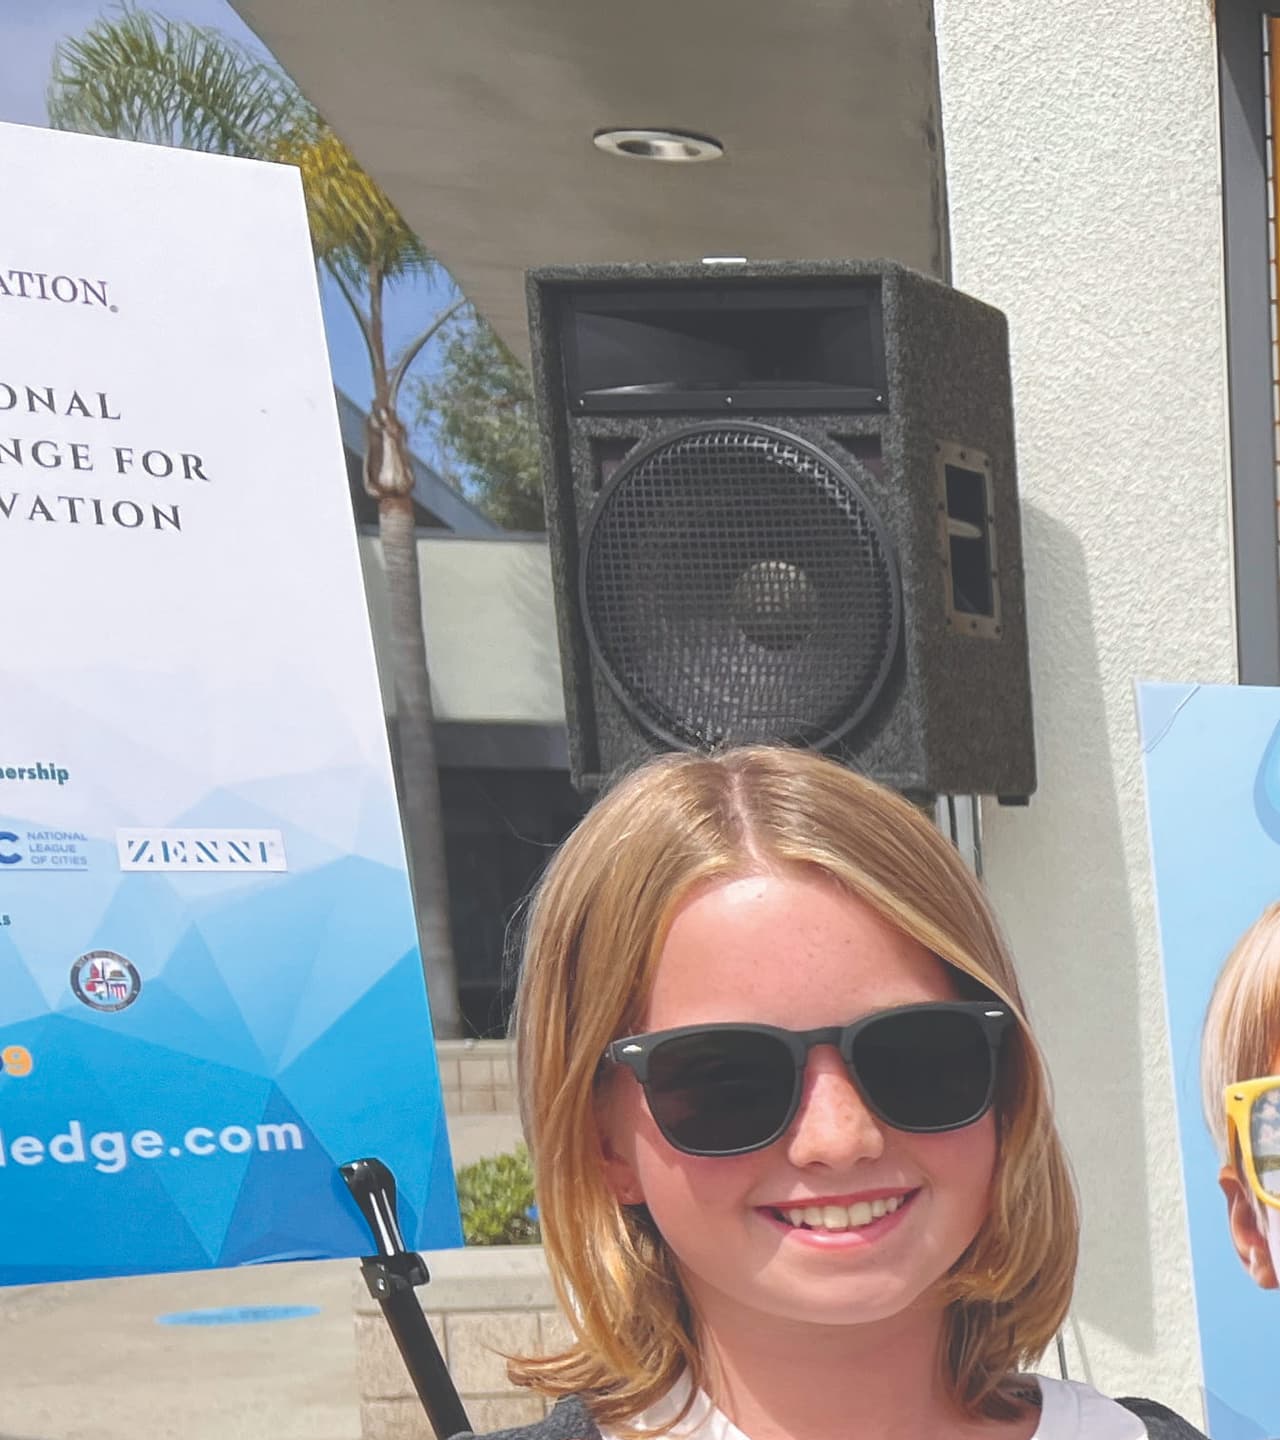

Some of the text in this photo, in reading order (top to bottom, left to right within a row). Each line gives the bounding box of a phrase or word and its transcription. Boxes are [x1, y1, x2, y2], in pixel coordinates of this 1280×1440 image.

[112, 446, 211, 482] FOR
[27, 831, 89, 841] NATIONAL
[29, 844, 77, 854] LEAGUE
[127, 840, 269, 863] ZENNI
[31, 856, 88, 865] OF CITIES
